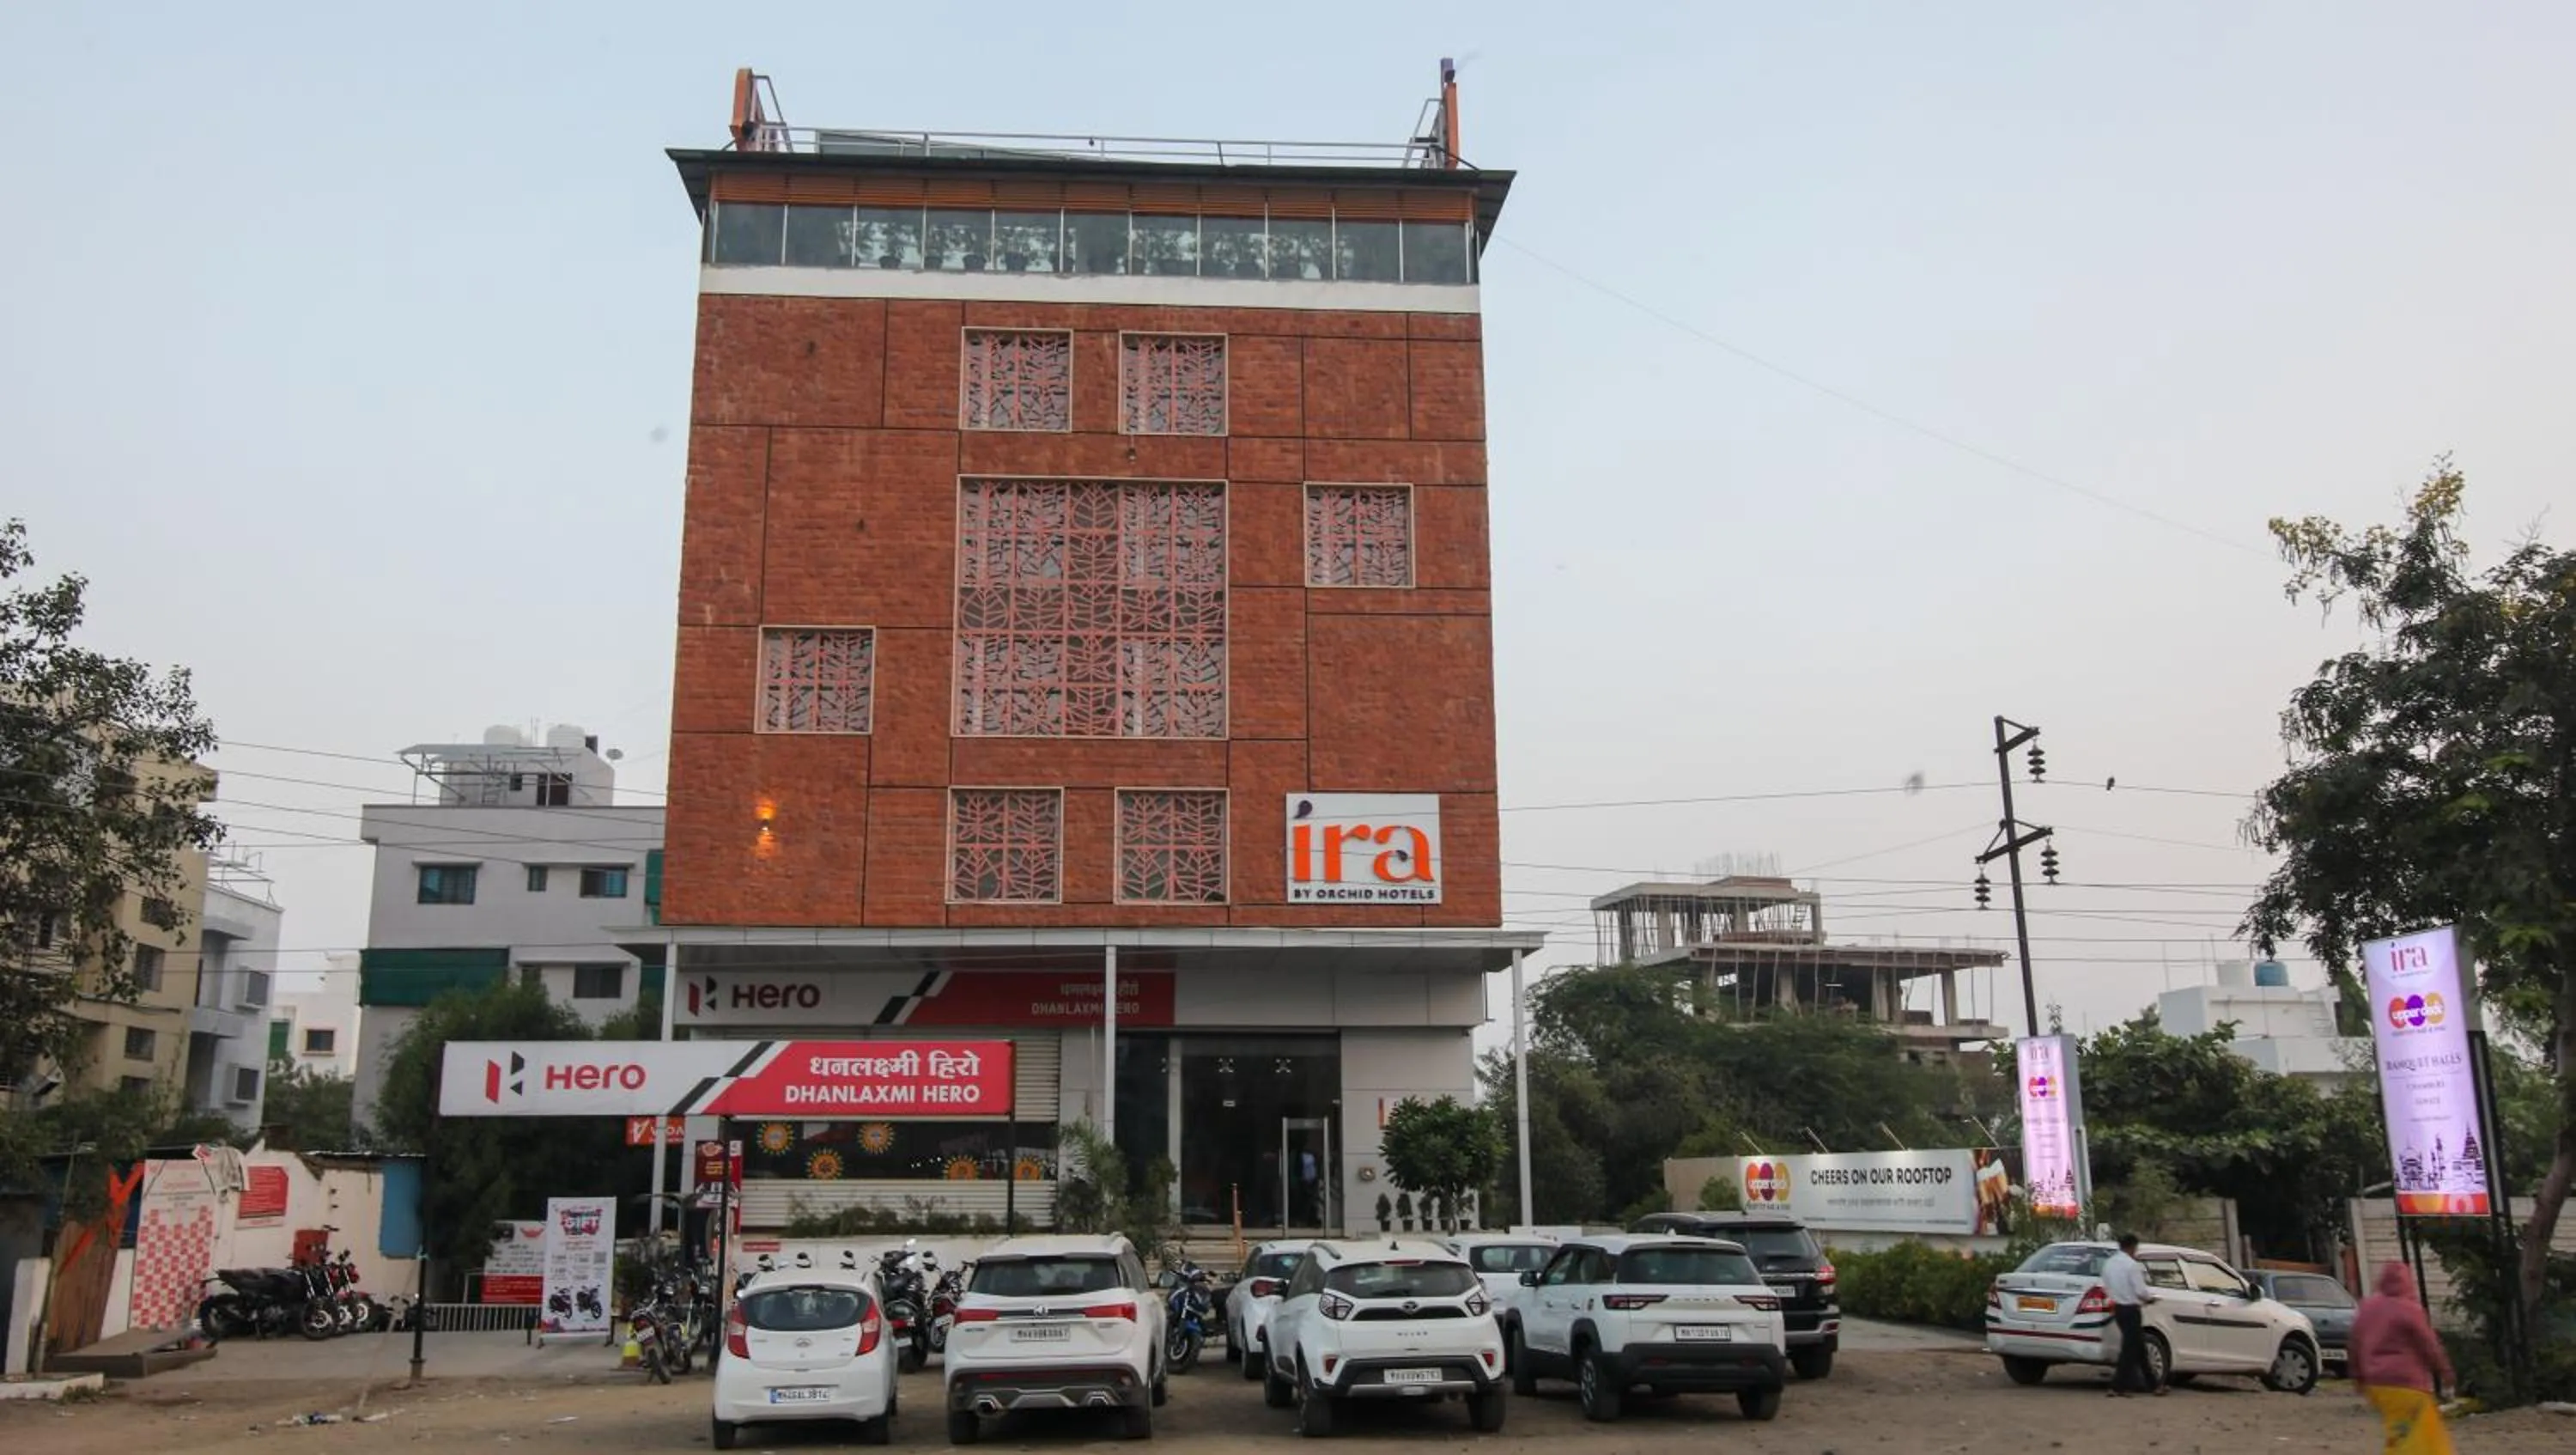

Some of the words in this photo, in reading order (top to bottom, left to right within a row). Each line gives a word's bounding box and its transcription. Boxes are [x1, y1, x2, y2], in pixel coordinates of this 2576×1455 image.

[1292, 800, 1435, 884] ira
[1294, 889, 1311, 899] BY
[1316, 889, 1374, 899] ORCHID
[1377, 889, 1435, 899] HOTELS
[2391, 941, 2428, 971] ira
[1031, 1002, 1103, 1015] DHANLAXMI
[1114, 1002, 1140, 1014] ERO
[810, 1050, 920, 1077] धनलक्ष्मी
[785, 1085, 915, 1103] DHANLAXMI
[922, 1085, 980, 1103] HERO
[1811, 1169, 1849, 1184] CHEERS
[1851, 1168, 1868, 1184] ON
[1870, 1167, 1893, 1184] OUR
[1897, 1166, 1952, 1184] ROOFTOP
